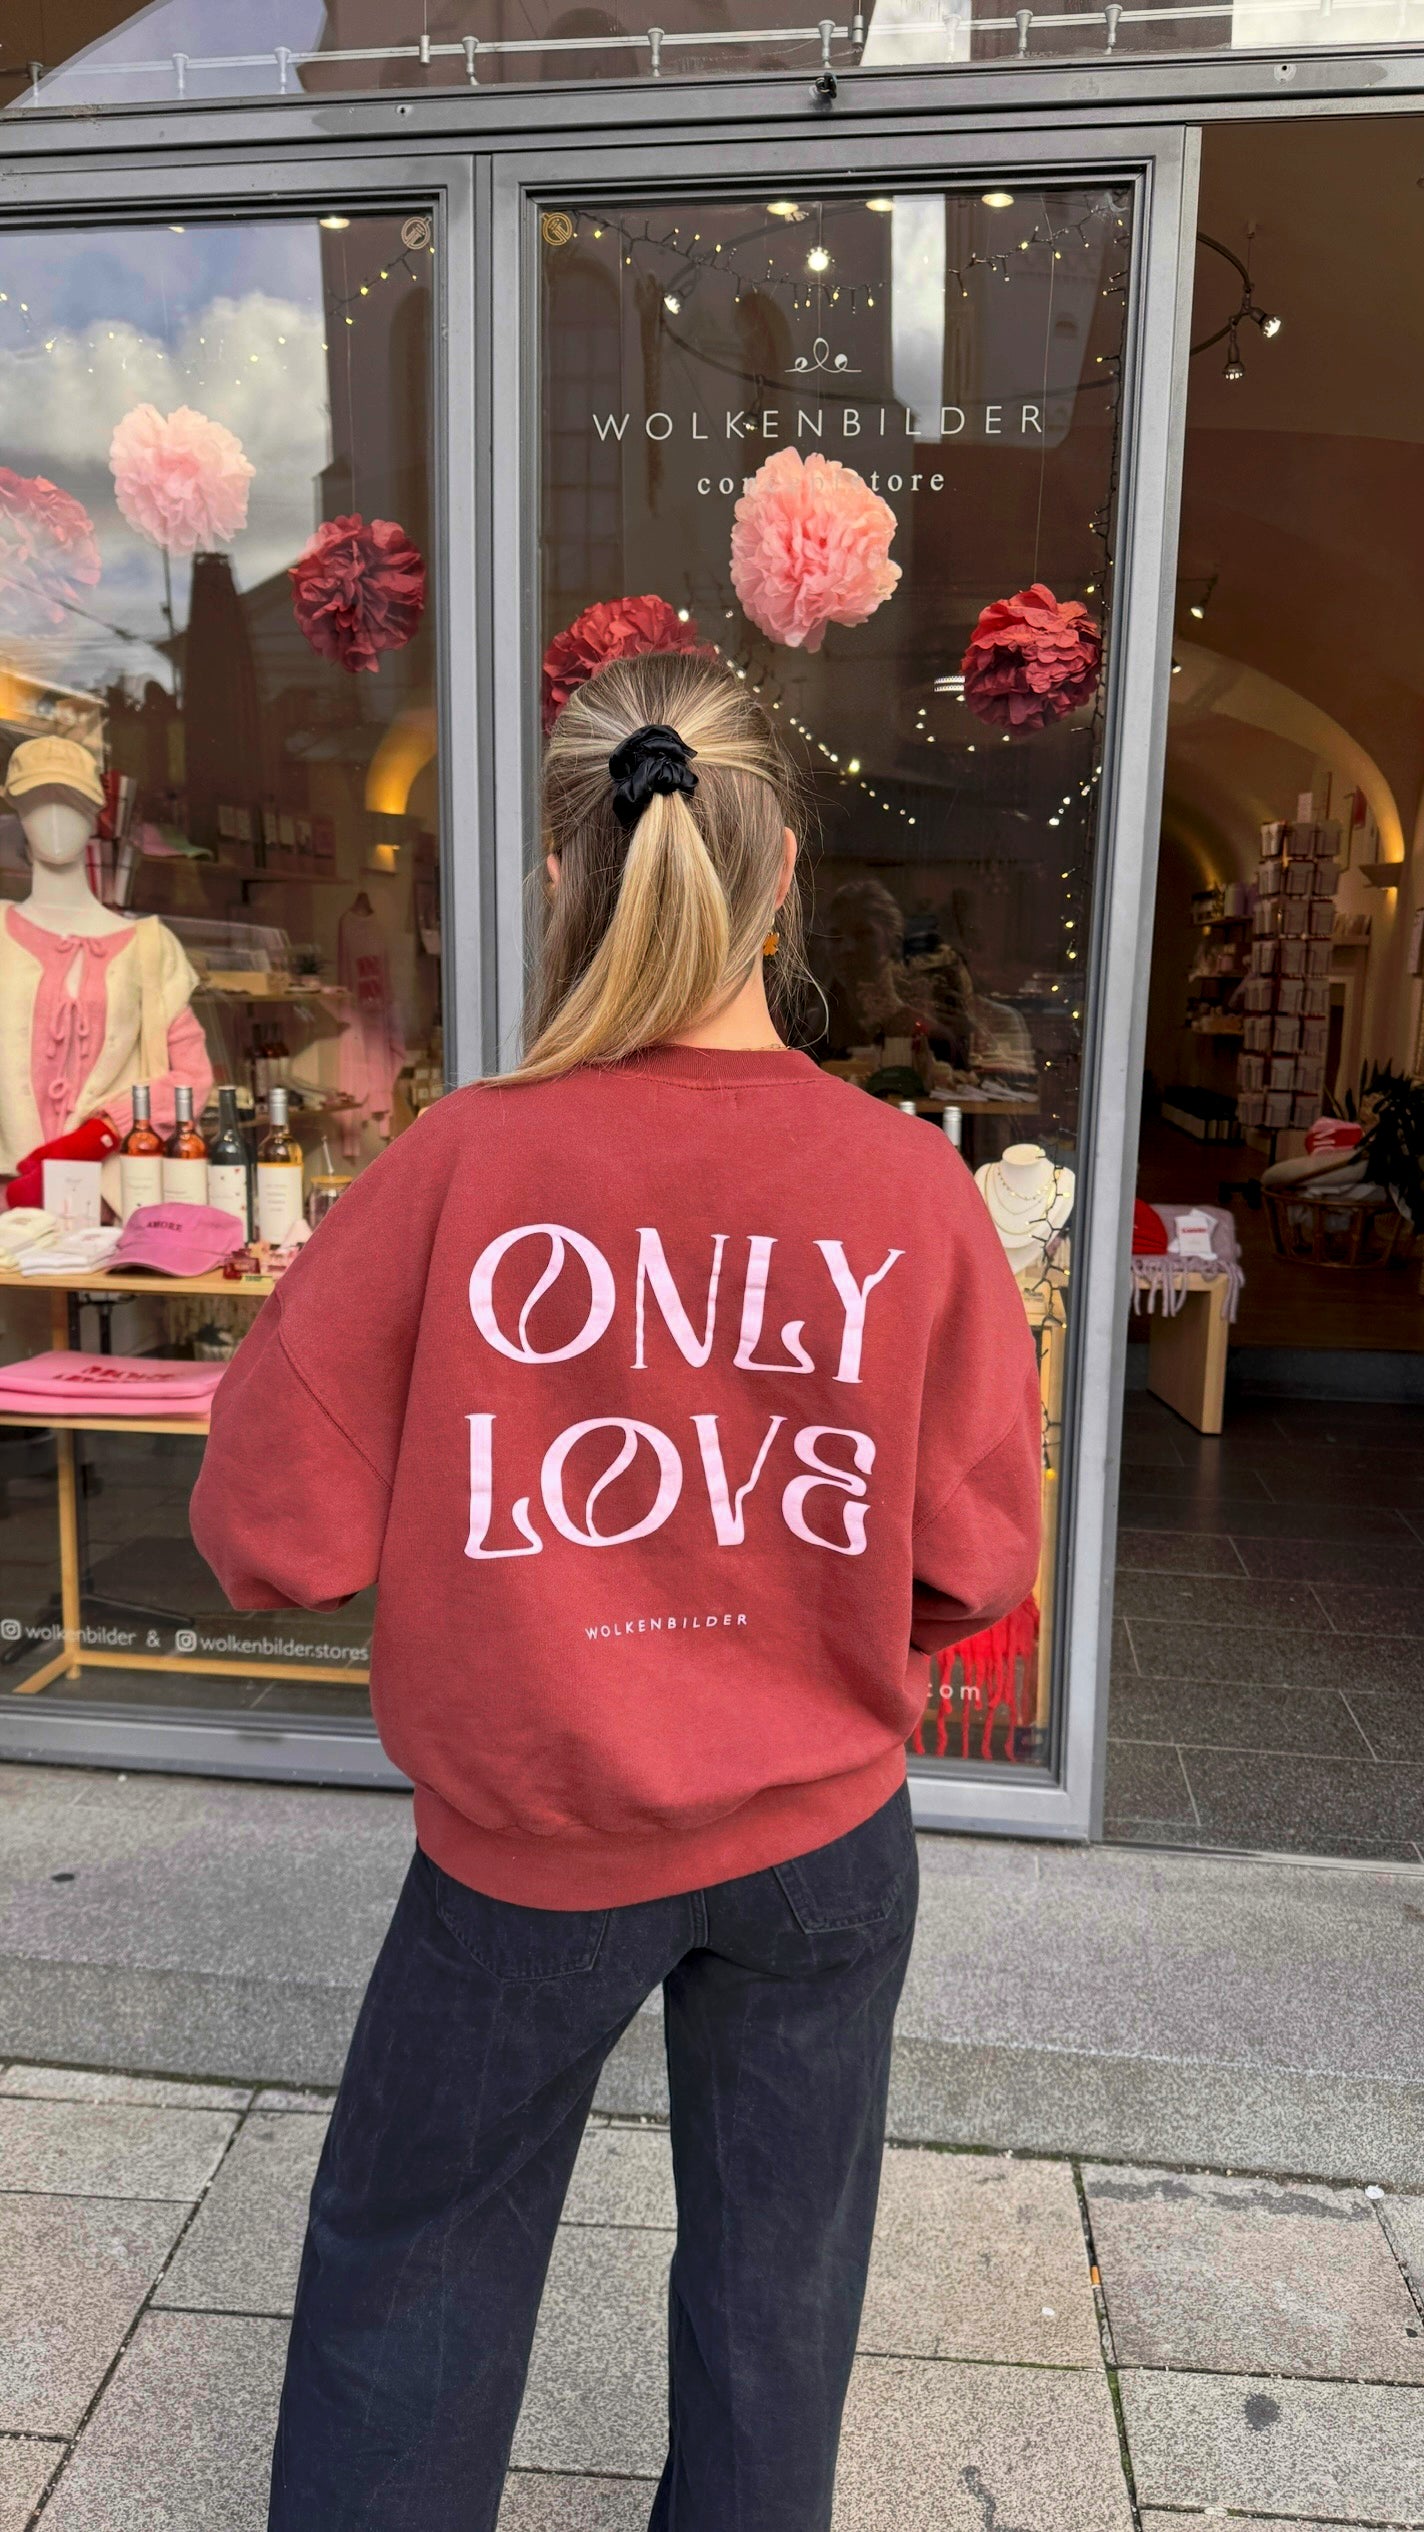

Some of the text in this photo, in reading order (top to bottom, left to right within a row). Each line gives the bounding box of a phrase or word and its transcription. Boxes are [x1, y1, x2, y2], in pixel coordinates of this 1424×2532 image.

[593, 405, 1043, 441] WOLKENBILDER
[146, 1221, 183, 1232] AMORE
[468, 1223, 906, 1384] ONLY
[464, 1413, 876, 1560] LOVE
[25, 1623, 370, 1661] wolkenbilder & wolkenbilder.stores
[585, 1614, 748, 1640] WOLKENBILDER
